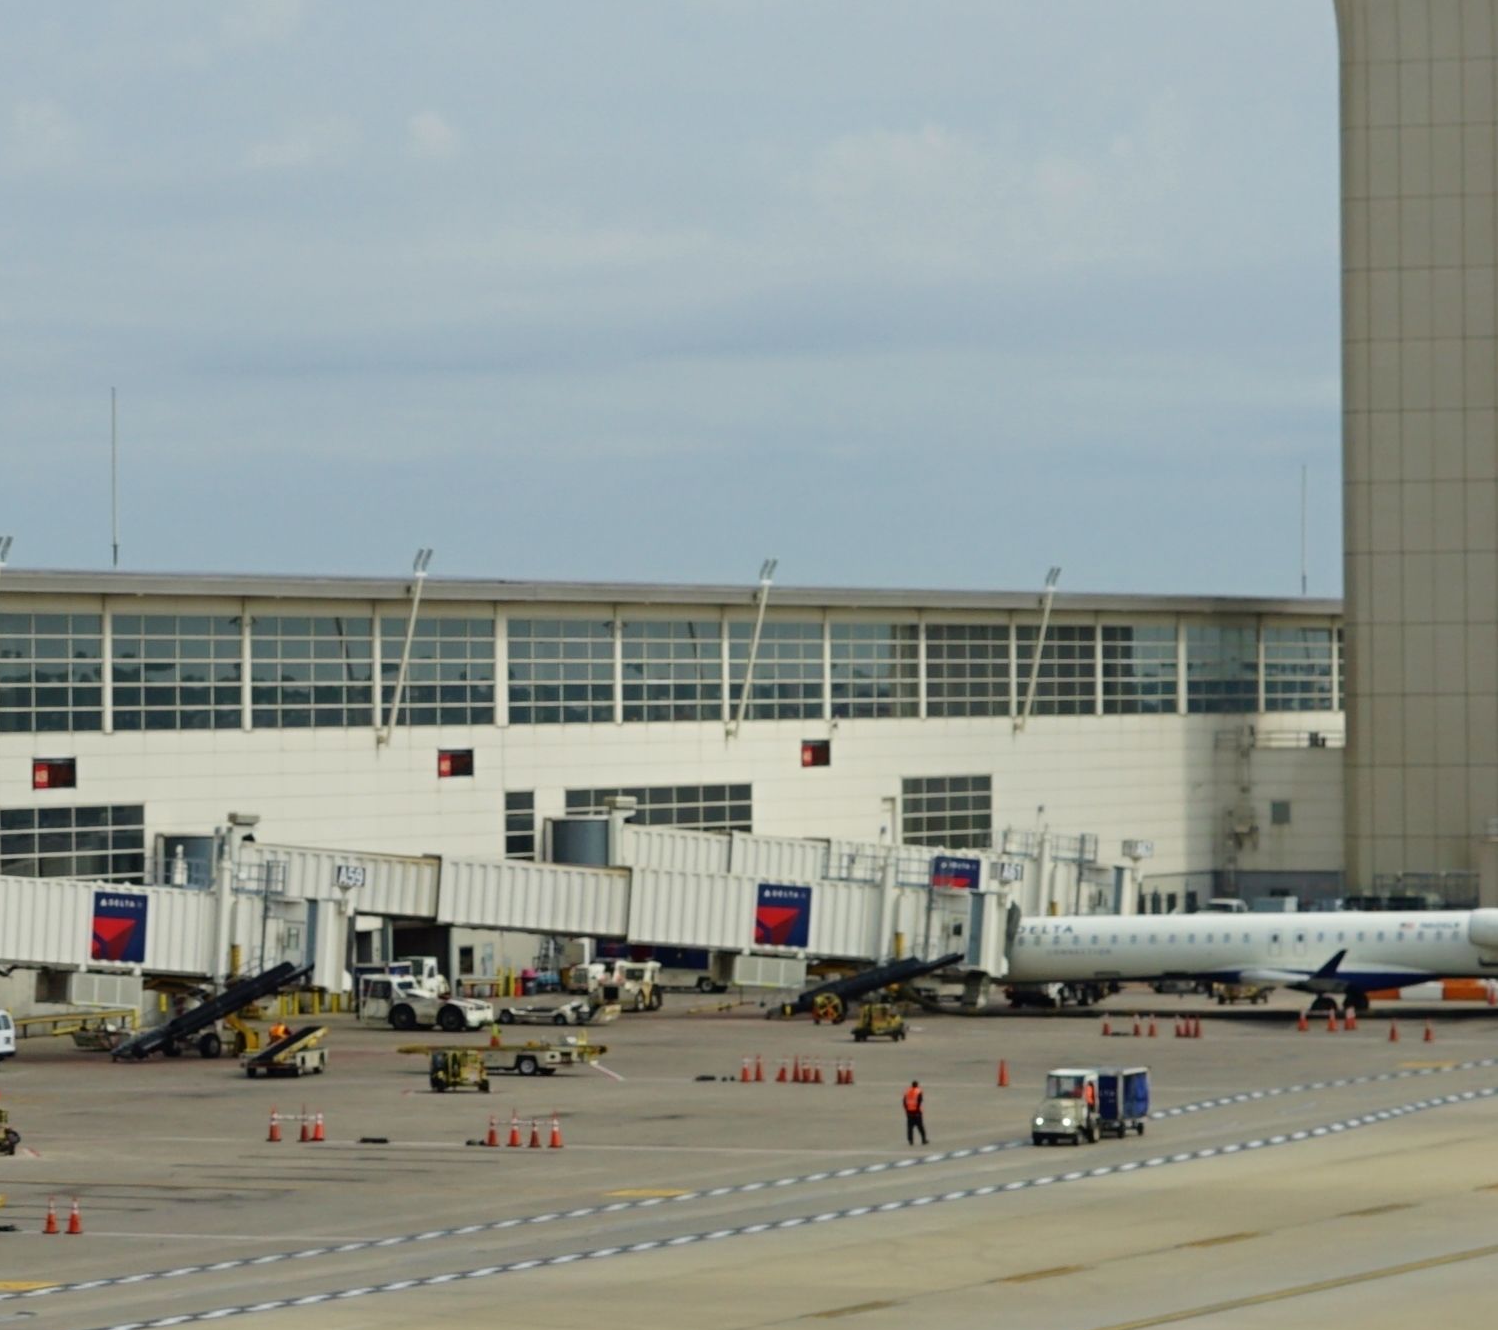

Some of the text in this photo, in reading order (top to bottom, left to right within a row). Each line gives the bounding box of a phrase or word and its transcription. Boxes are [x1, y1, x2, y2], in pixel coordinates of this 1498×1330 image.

[339, 866, 364, 886] A59
[772, 889, 799, 899] DELTA
[108, 898, 135, 908] DELTA
